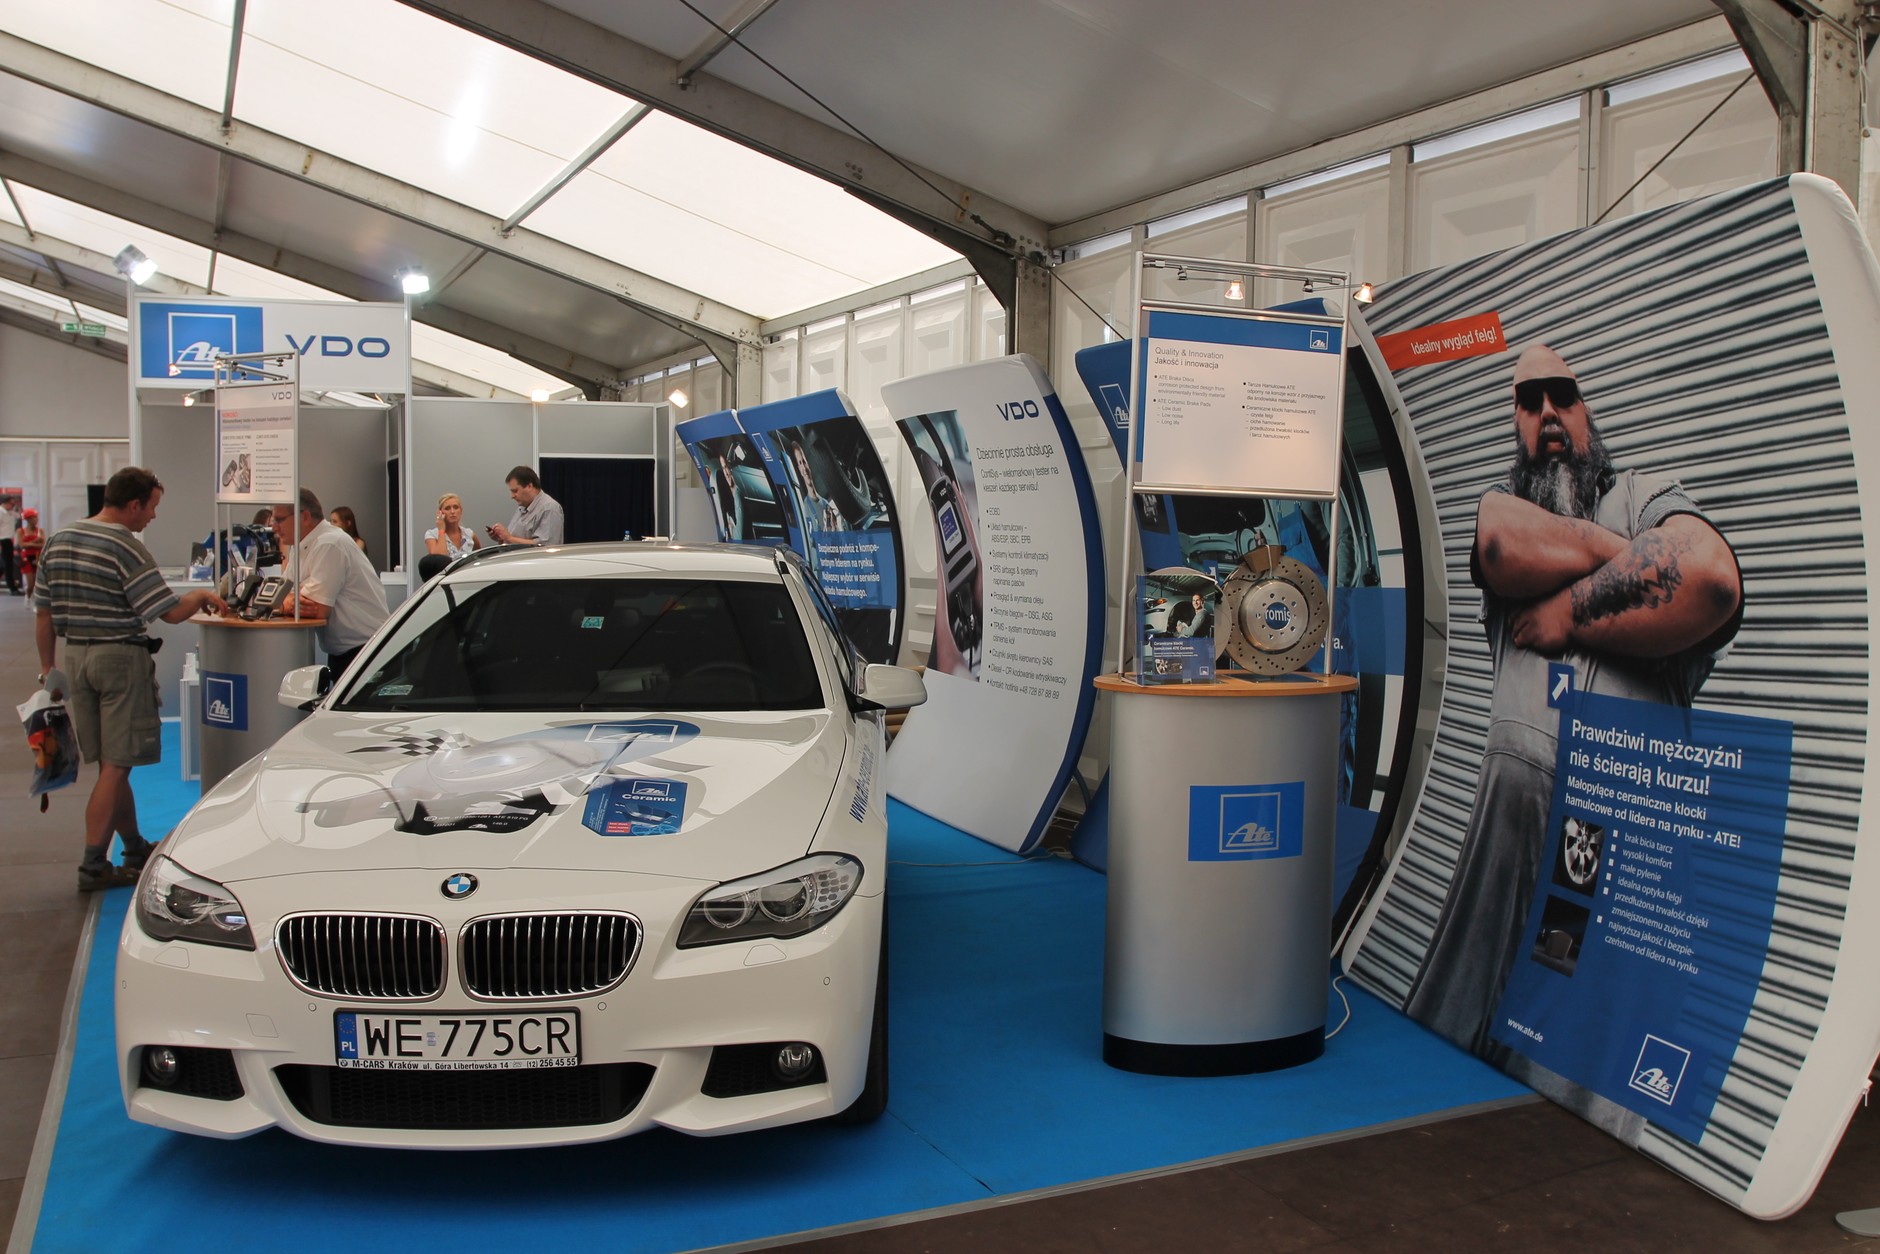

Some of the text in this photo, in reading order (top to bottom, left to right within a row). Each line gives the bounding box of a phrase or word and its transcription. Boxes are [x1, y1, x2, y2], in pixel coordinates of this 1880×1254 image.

[285, 334, 391, 358] VDO
[1411, 326, 1497, 355] Idealny wygląd felg!
[1155, 346, 1179, 357] Quality
[1189, 349, 1224, 359] Innovation
[1155, 357, 1219, 370] Jakość innowacja
[272, 392, 292, 400] VDO
[996, 400, 1039, 421] VDO
[976, 444, 1054, 460] Dziecinnie prosta obsługa
[1035, 467, 1049, 476] tester
[1051, 466, 1059, 475] na
[1042, 612, 1053, 621] ASG
[1042, 657, 1053, 666] SAS
[1572, 719, 1742, 769] Prawdziwi mężczyźni
[1570, 749, 1710, 795] nie ścierają kurzu!
[622, 793, 676, 802] Ceramic
[1568, 775, 1707, 821] Małopylące ceramiczne klocki
[1565, 793, 1741, 848] hamulcowe od lidera na rynku ATE!
[1226, 822, 1274, 847] Ate
[1625, 832, 1673, 854] brak bicia tarcz
[1622, 848, 1672, 869] wysoki komfort
[1637, 867, 1661, 882] pylenie
[1618, 876, 1682, 904] idealna optyka felgi
[1615, 891, 1708, 928] przedłużona trwałość dzięki
[1612, 906, 1691, 939] zmniejszonemu zużyciu
[1608, 920, 1694, 956] najwyższa jakość bezpie-
[1605, 934, 1698, 974] czeństwo od lidera na rynku
[364, 1017, 571, 1057] WE 775CR
[1507, 1018, 1544, 1043] www.ate.de
[342, 1041, 355, 1051] PL
[352, 1059, 385, 1069] M-CARS
[388, 1060, 419, 1070] Kraków
[423, 1062, 432, 1070] ul.
[435, 1061, 451, 1070] Góra
[454, 1061, 497, 1070] Libertowska
[526, 1060, 538, 1068] (12)
[539, 1058, 553, 1067] 256
[555, 1058, 565, 1066] 45
[567, 1058, 576, 1066] 55
